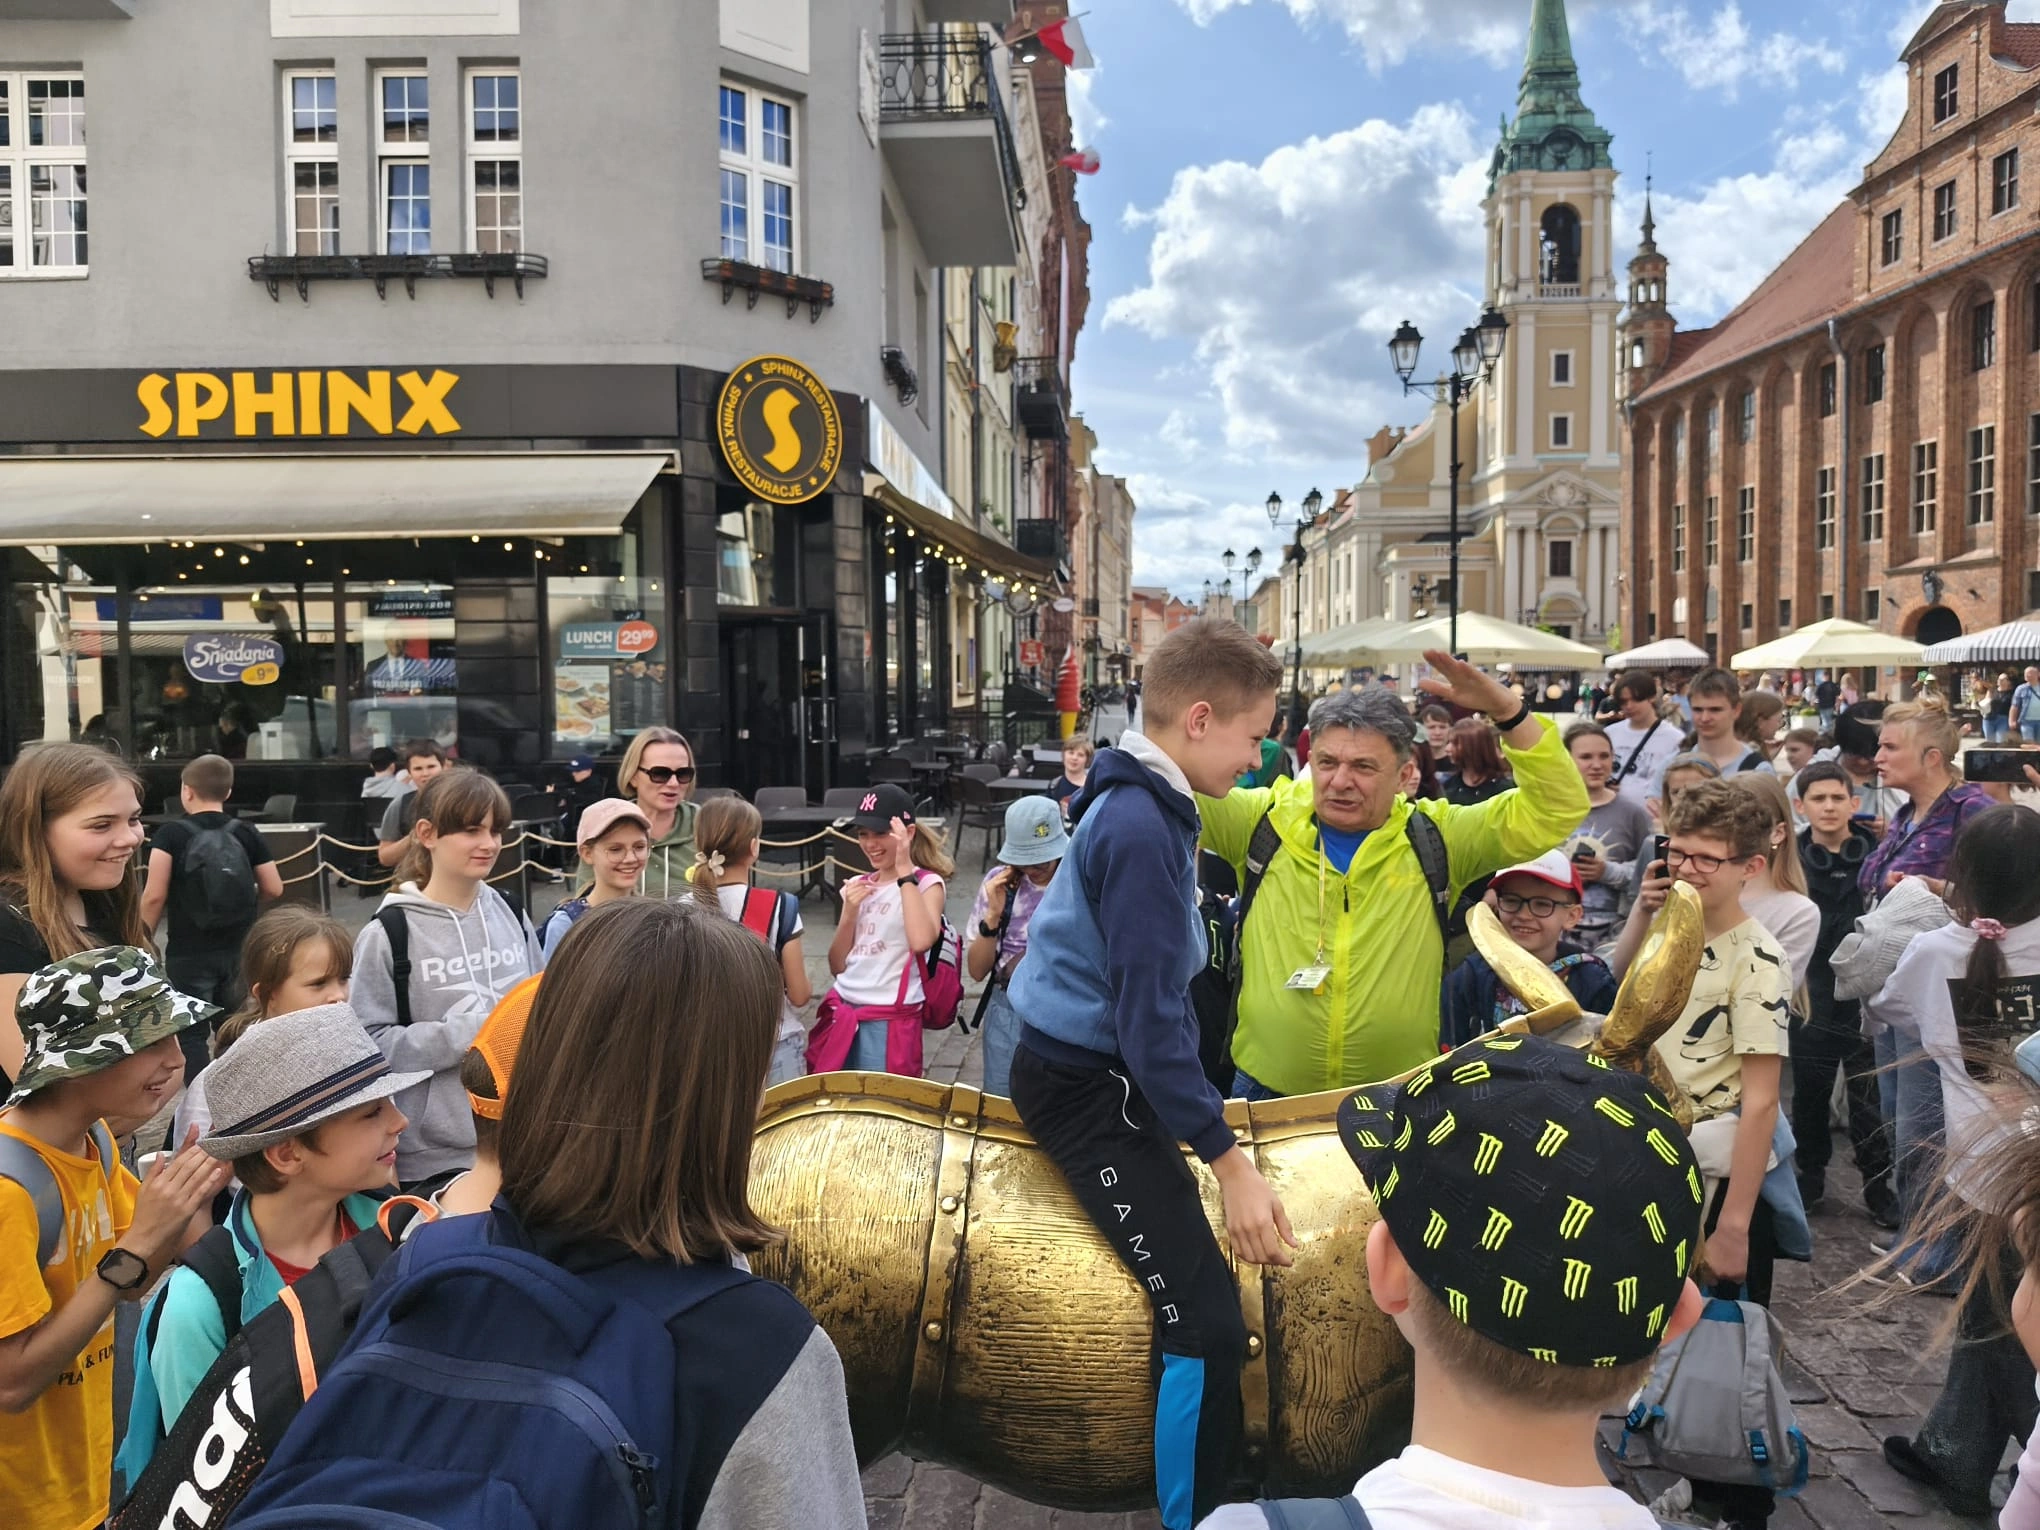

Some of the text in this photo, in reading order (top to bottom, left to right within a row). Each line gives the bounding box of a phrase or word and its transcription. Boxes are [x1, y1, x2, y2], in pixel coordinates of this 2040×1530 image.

[137, 369, 462, 437] SPHINX
[761, 362, 837, 473] SPHINX RESTAURACJE
[723, 386, 803, 497] SPHINX RESTAURACJE
[566, 631, 613, 644] LUNCH
[421, 943, 527, 984] Reebok
[1099, 1166, 1180, 1324] GAMER
[85, 1354, 95, 1369] &
